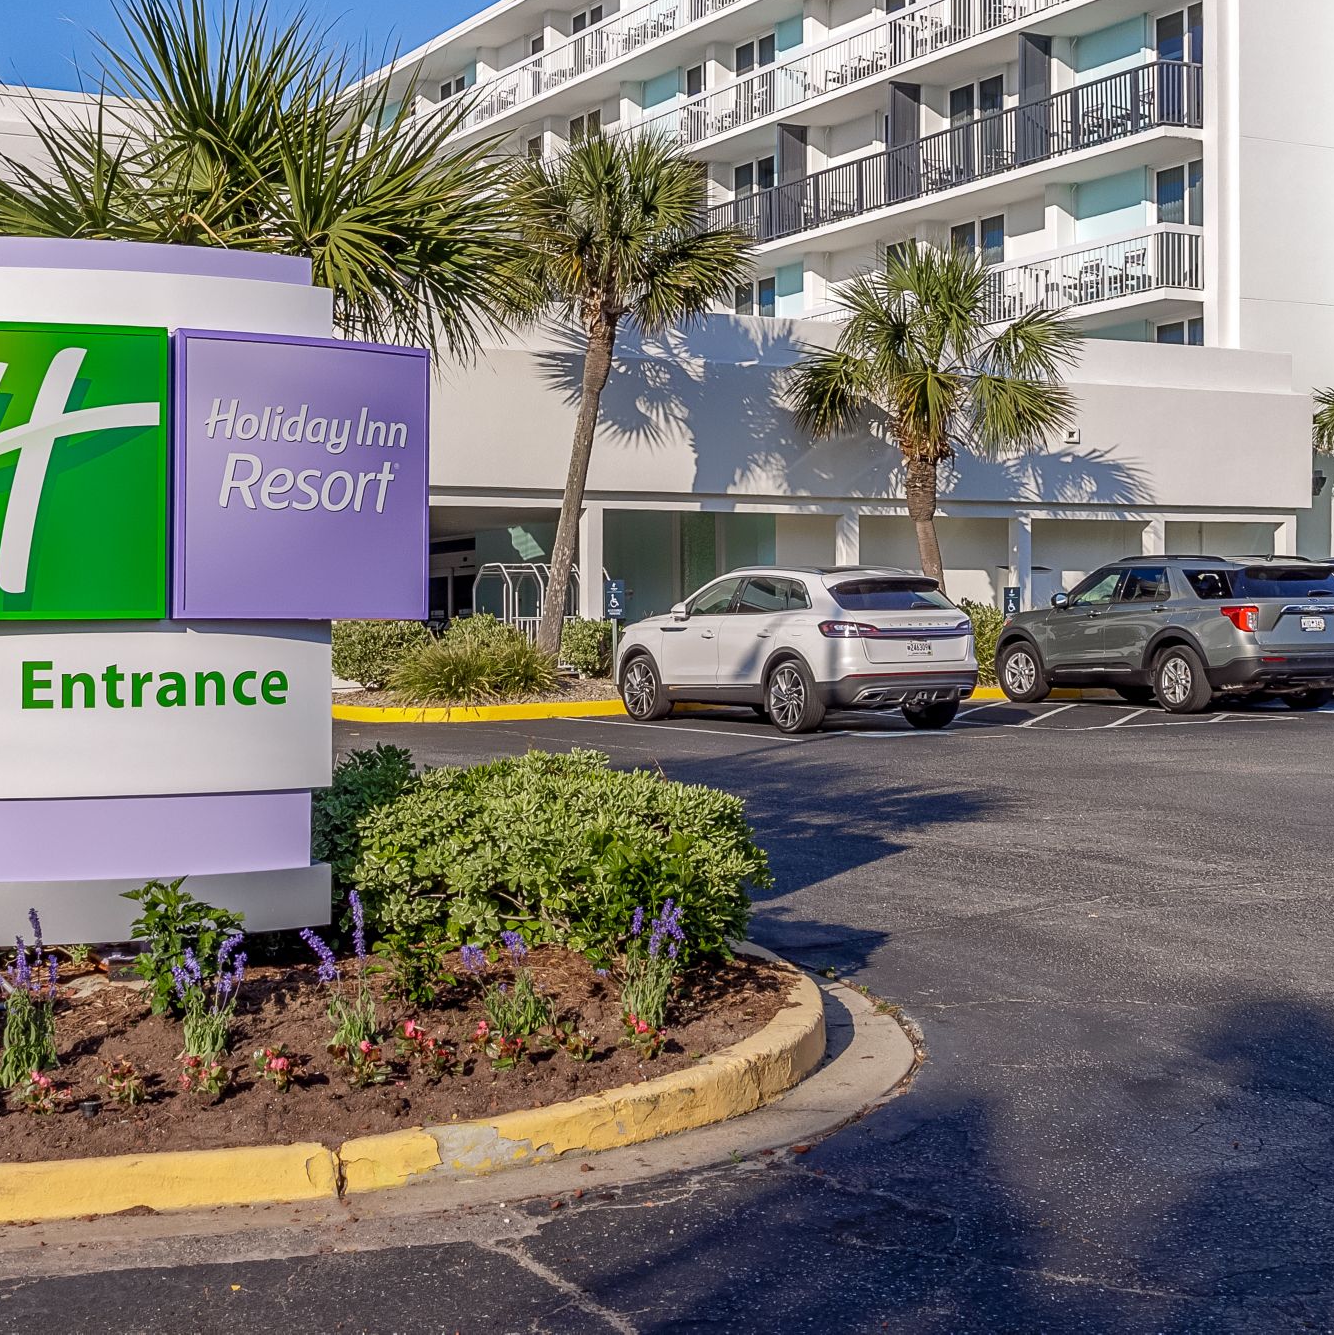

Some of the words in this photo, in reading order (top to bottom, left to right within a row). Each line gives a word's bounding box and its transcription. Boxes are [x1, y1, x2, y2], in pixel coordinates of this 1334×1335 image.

[204, 398, 352, 454] Holiday
[356, 407, 408, 448] Inn
[218, 452, 395, 514] Resort
[21, 660, 289, 710] Entrance
